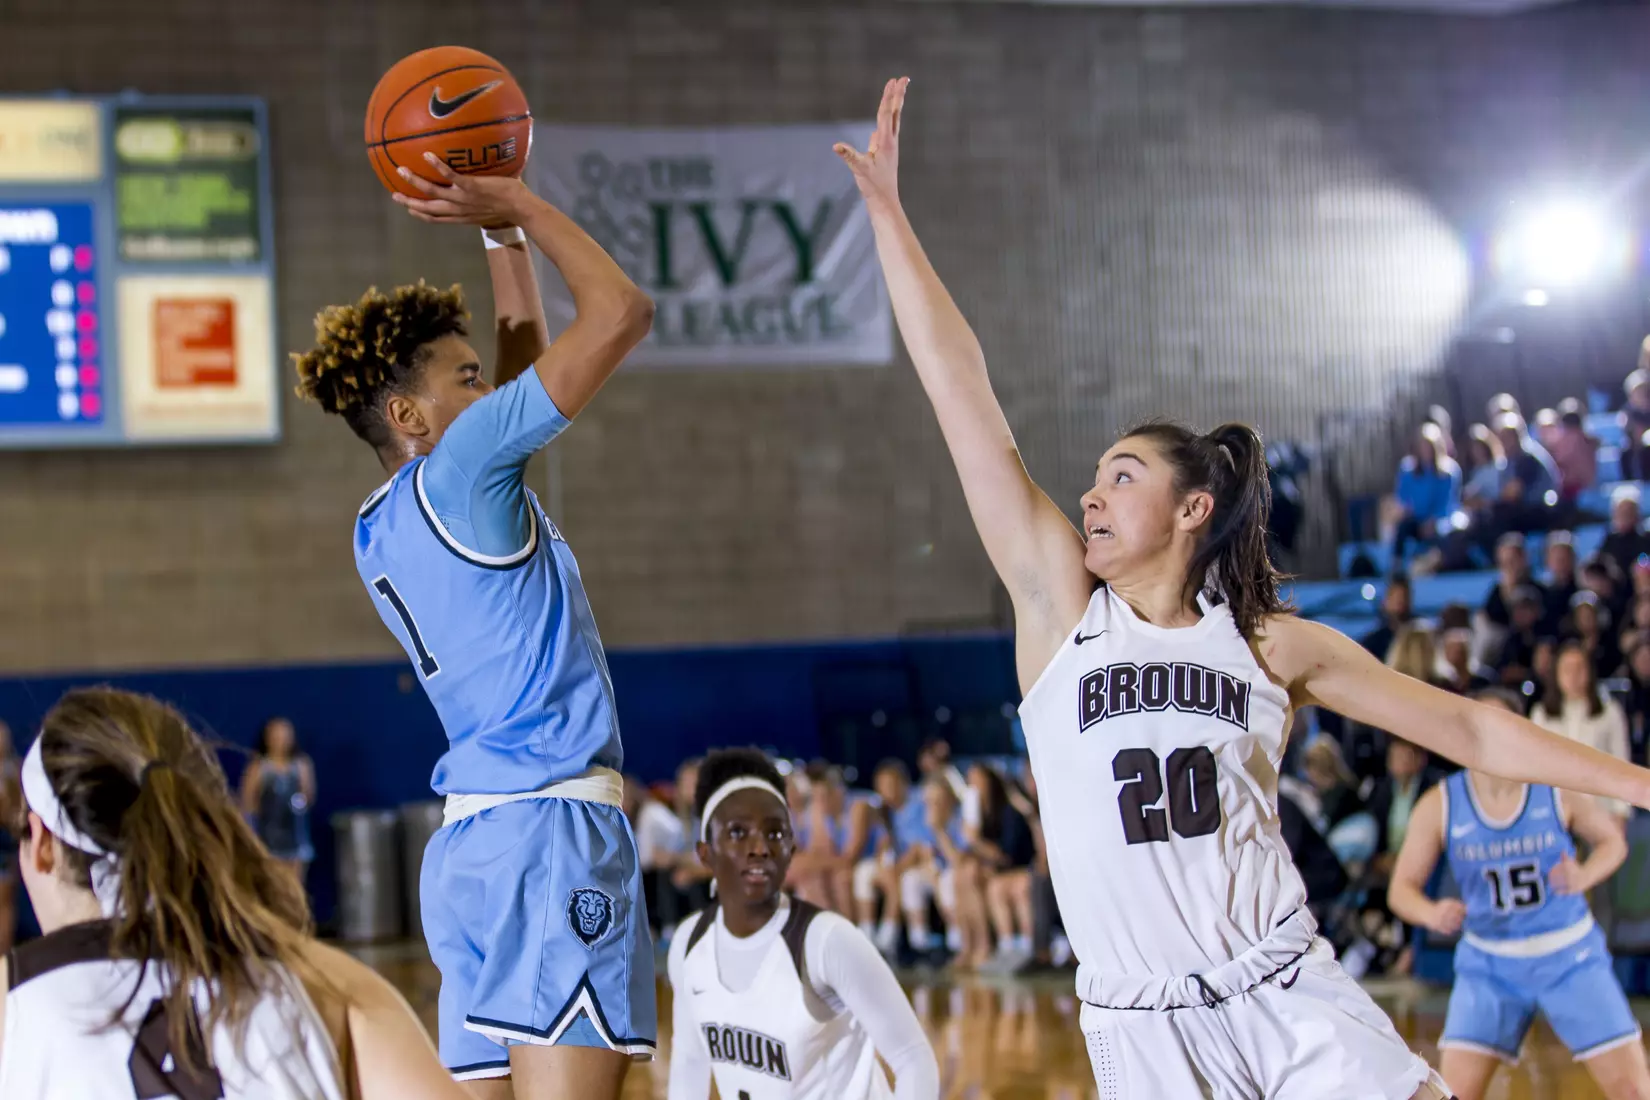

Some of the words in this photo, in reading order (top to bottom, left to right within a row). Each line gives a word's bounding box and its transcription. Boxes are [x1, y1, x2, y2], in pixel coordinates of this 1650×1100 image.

[446, 137, 517, 168] ELITE
[650, 199, 832, 288] IVY
[371, 574, 441, 680] 1
[1079, 662, 1251, 733] BROWN
[1112, 746, 1222, 845] 20
[1481, 856, 1546, 916] 15
[700, 1021, 792, 1081] ROWN
